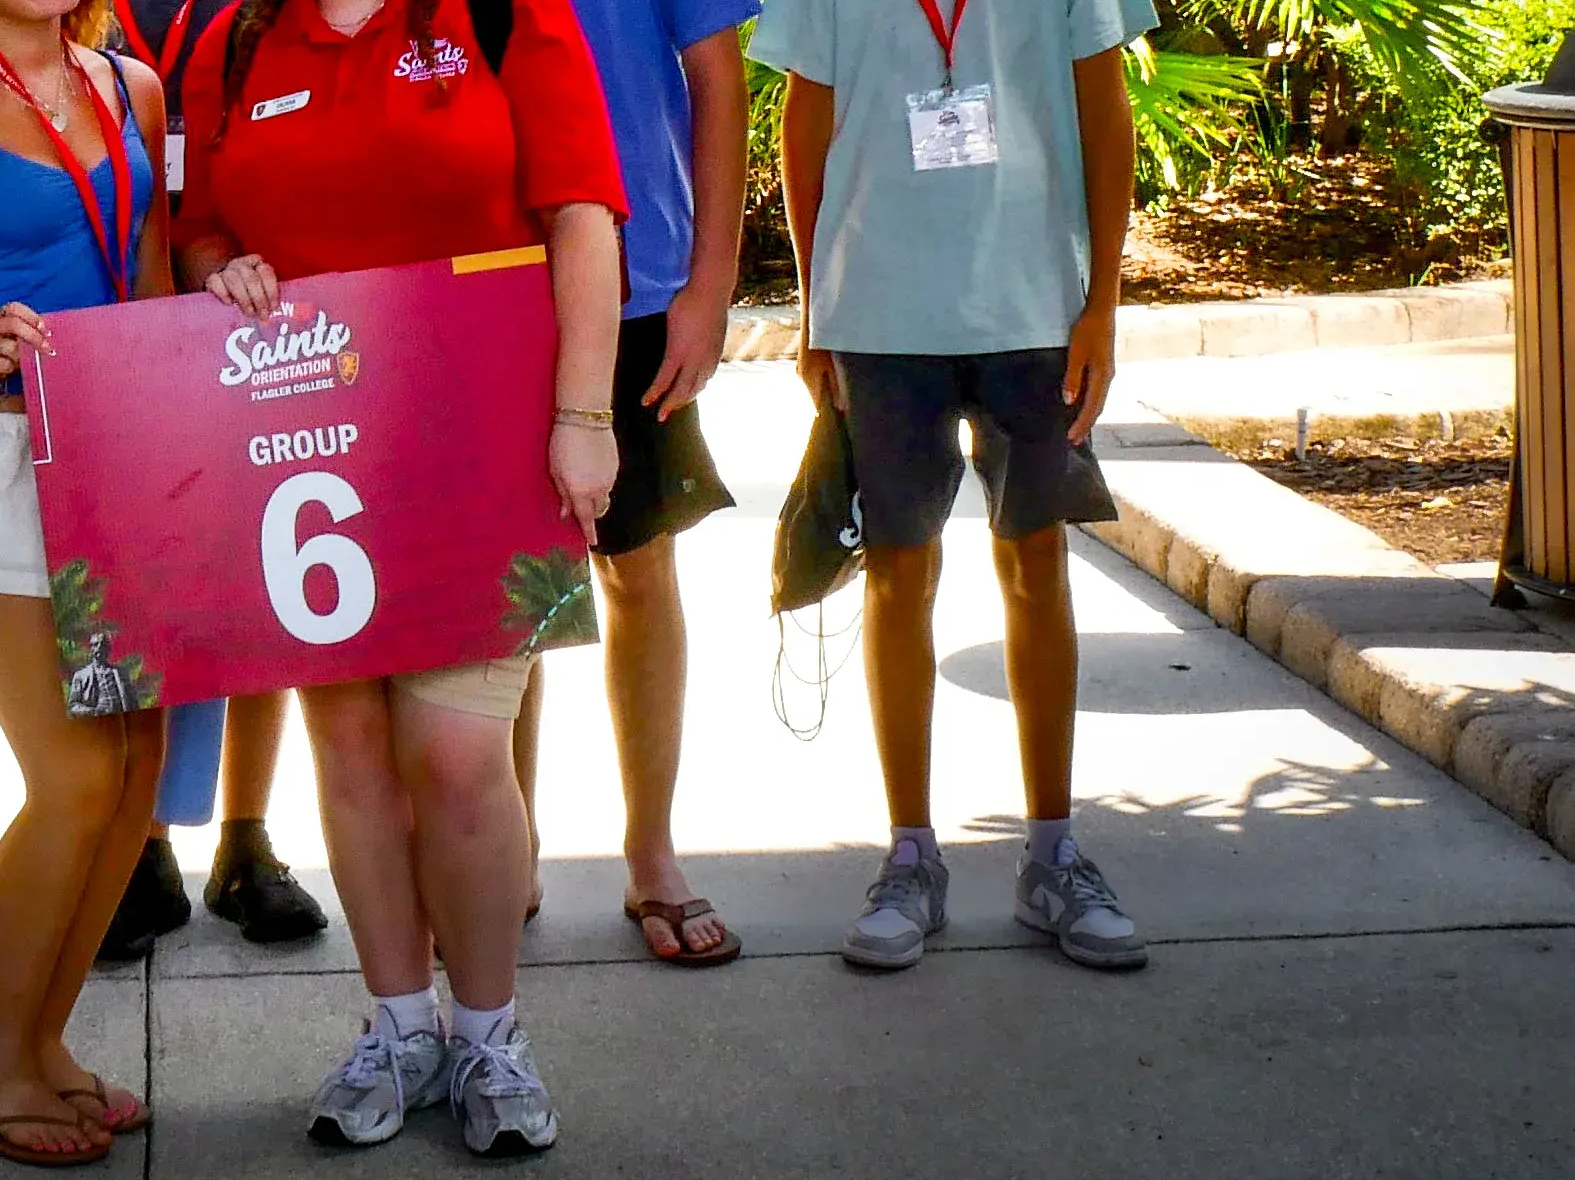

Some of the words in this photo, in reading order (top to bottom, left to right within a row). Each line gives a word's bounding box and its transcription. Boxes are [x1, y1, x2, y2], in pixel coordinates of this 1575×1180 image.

[394, 42, 464, 77] Sants
[219, 309, 351, 386] Saints
[250, 384, 292, 401] FLAGLER
[292, 377, 335, 394] COLLEGE
[251, 358, 331, 386] ORIENTATION
[248, 423, 359, 466] GROUP
[260, 470, 378, 645] 6
